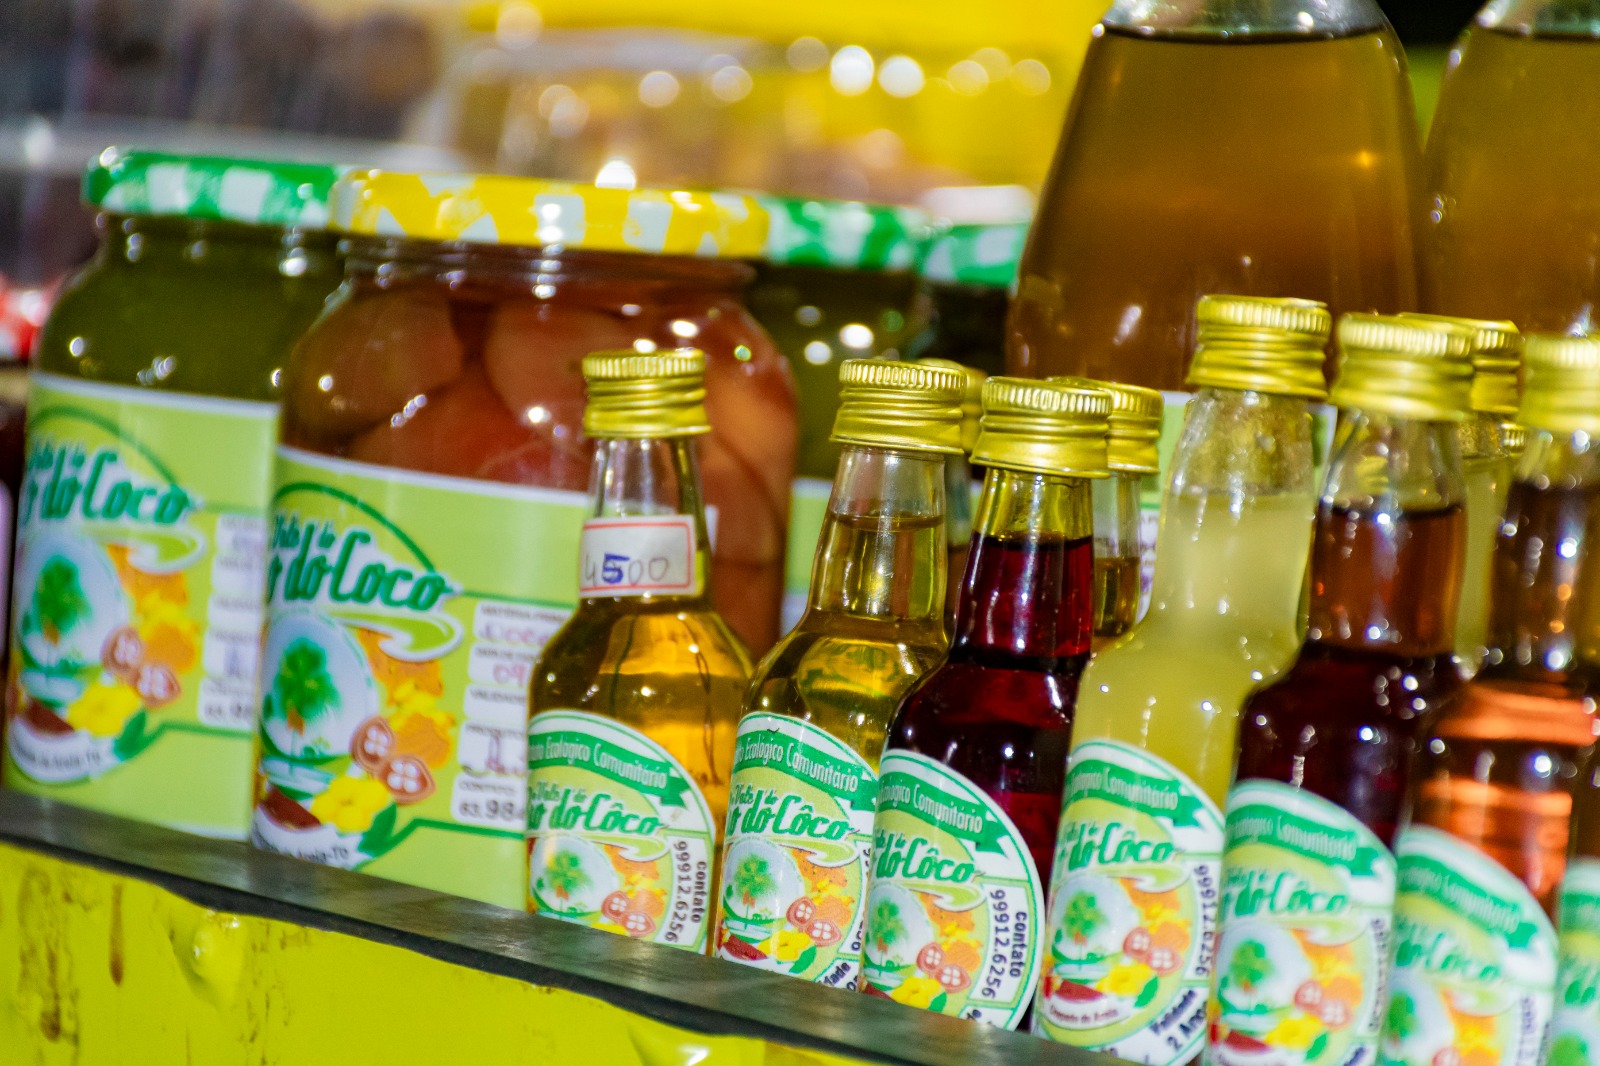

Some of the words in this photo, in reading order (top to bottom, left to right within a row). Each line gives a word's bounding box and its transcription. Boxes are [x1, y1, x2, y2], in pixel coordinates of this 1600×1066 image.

[330, 531, 455, 611] Coco
[593, 742, 667, 789] Comunitário
[743, 733, 784, 766] Ecológico
[786, 742, 859, 793] Comunitário
[548, 788, 585, 830] do
[583, 793, 665, 835] Côco
[741, 790, 775, 833] do
[772, 795, 854, 841] Côco
[913, 783, 983, 834] Comunitário
[876, 833, 905, 879] do
[902, 837, 976, 883] Côco
[664, 841, 692, 943] 99912.6256
[691, 861, 707, 924] contato
[980, 889, 1010, 999] 99912.6256
[1009, 911, 1028, 978] contato
[1166, 1036, 1184, 1051] 2
